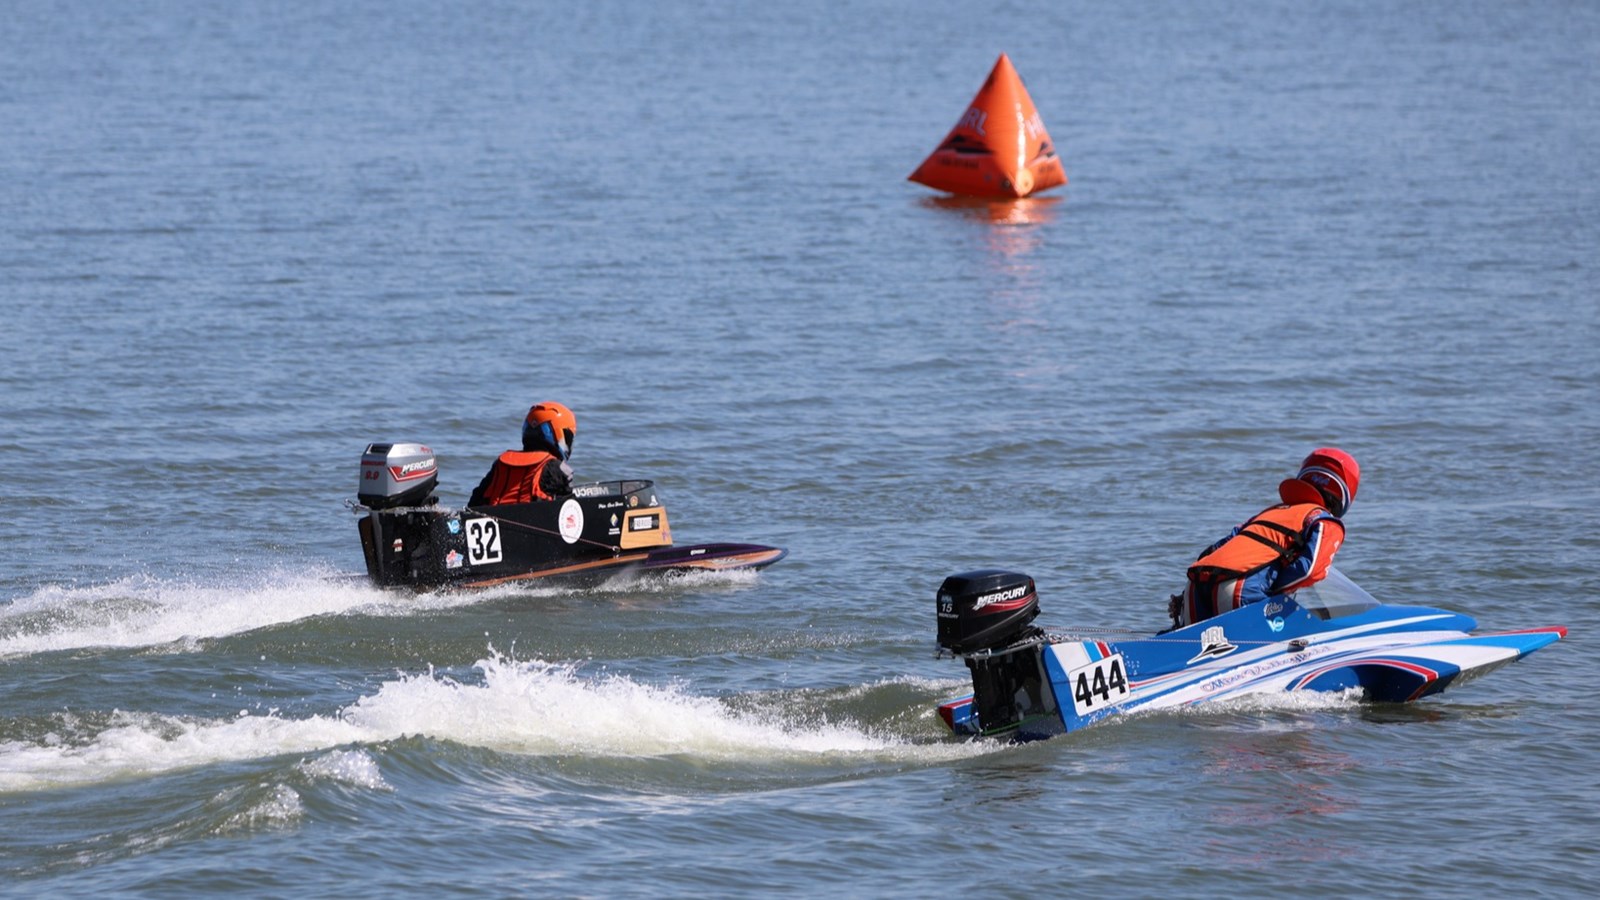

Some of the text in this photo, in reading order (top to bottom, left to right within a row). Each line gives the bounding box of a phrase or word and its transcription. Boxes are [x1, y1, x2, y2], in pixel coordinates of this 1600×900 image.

[401, 458, 435, 475] MERCURY
[470, 521, 499, 560] 32
[942, 604, 953, 613] 15
[972, 586, 1027, 611] MERCURY
[1075, 659, 1126, 707] 444
